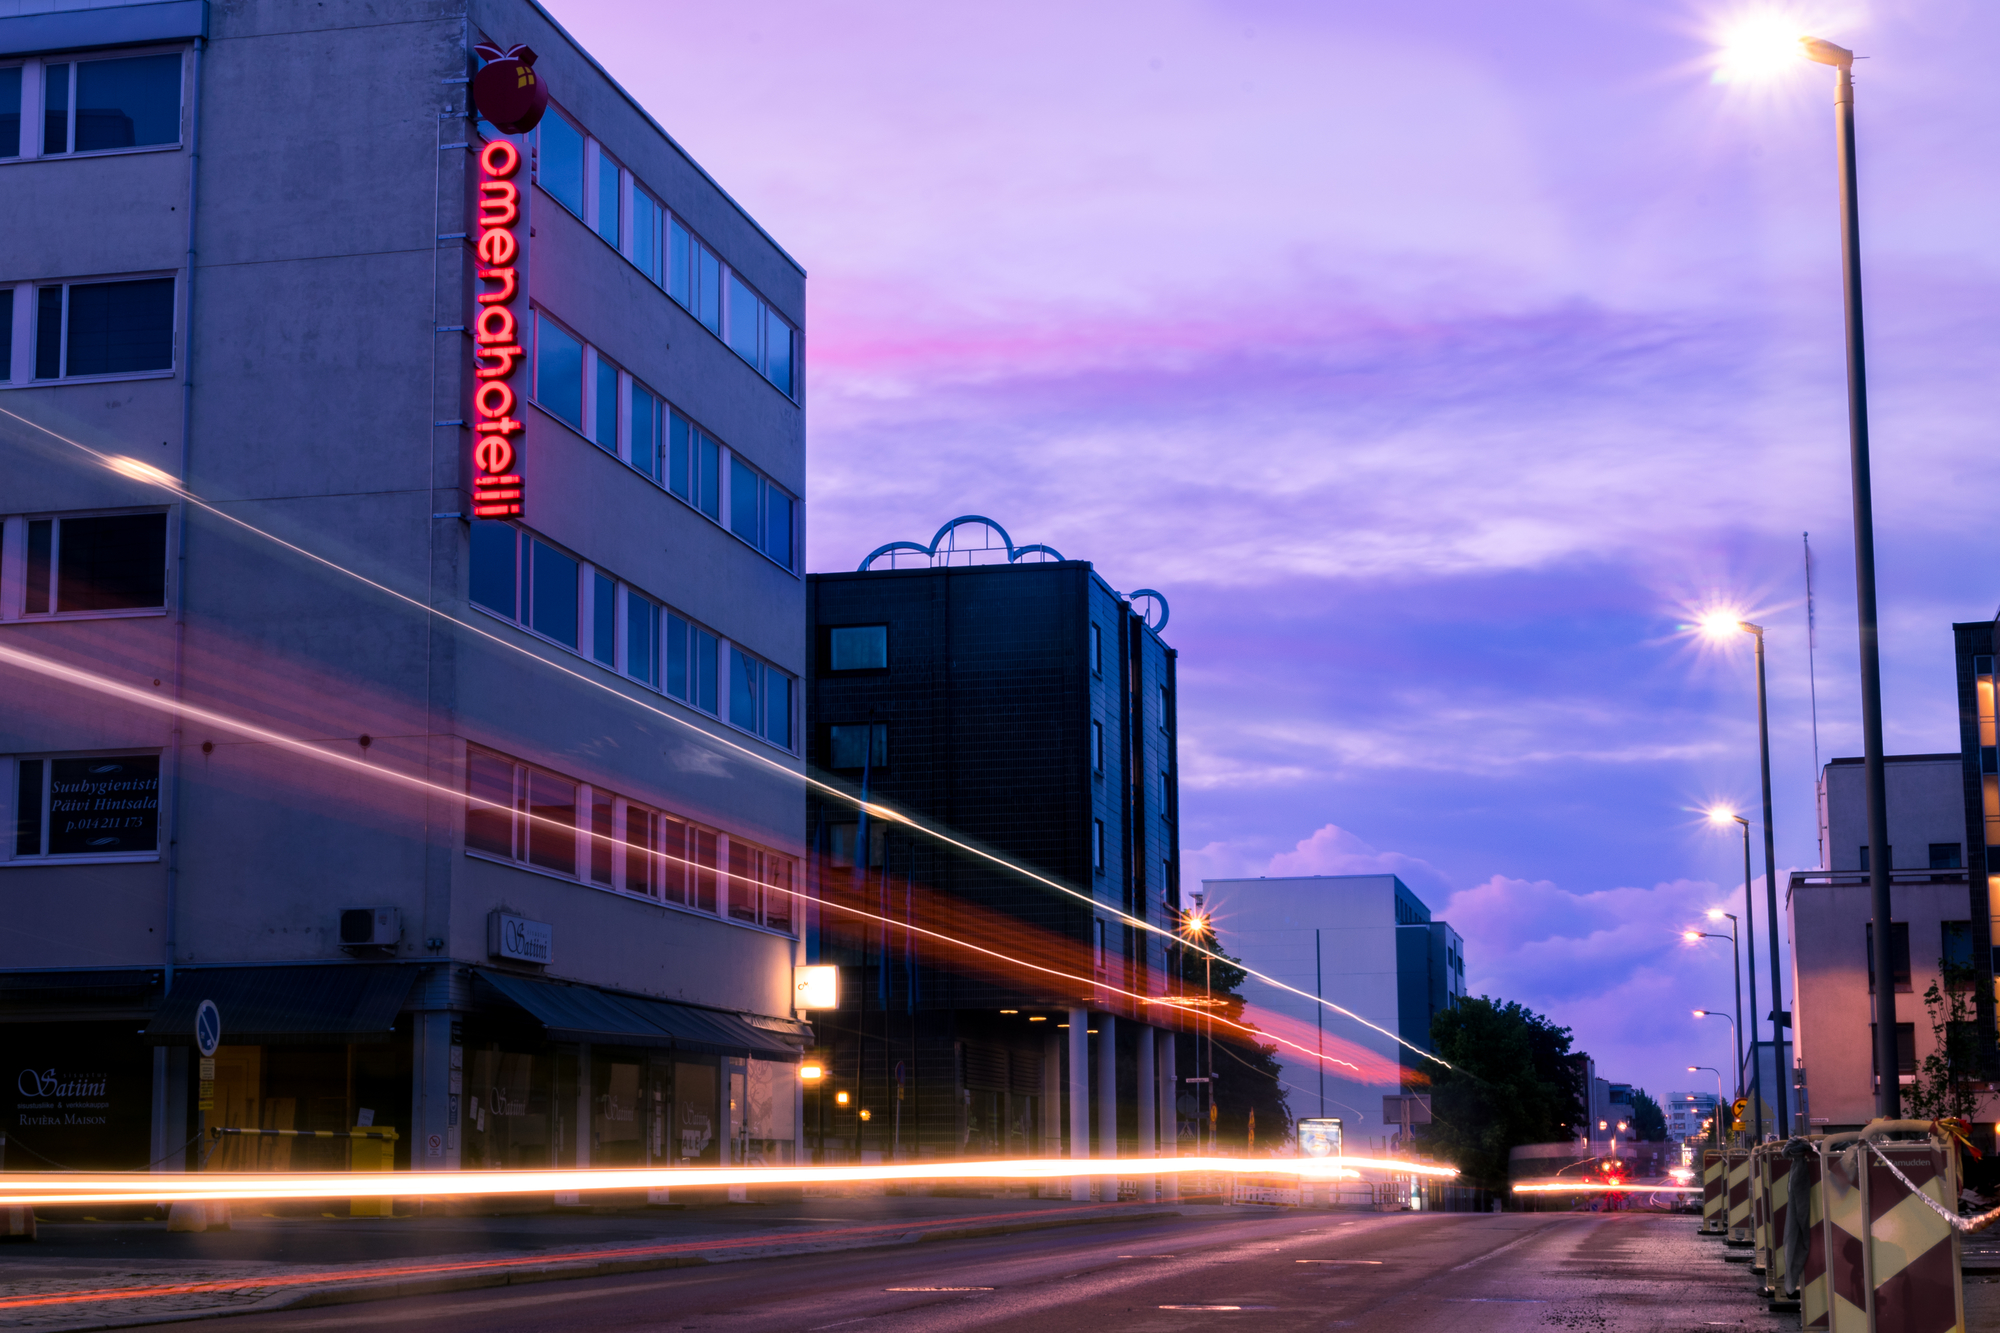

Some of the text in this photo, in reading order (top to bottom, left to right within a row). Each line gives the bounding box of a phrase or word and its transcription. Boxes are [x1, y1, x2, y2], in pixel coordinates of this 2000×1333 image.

[475, 139, 525, 517] omenahotelli
[51, 797, 157, 812] Päivi Hintsala
[100, 816, 120, 829] 211
[123, 816, 143, 828] 173
[505, 920, 548, 960] Satiini
[17, 1067, 107, 1098] Satiini
[489, 1086, 526, 1117] Satiini
